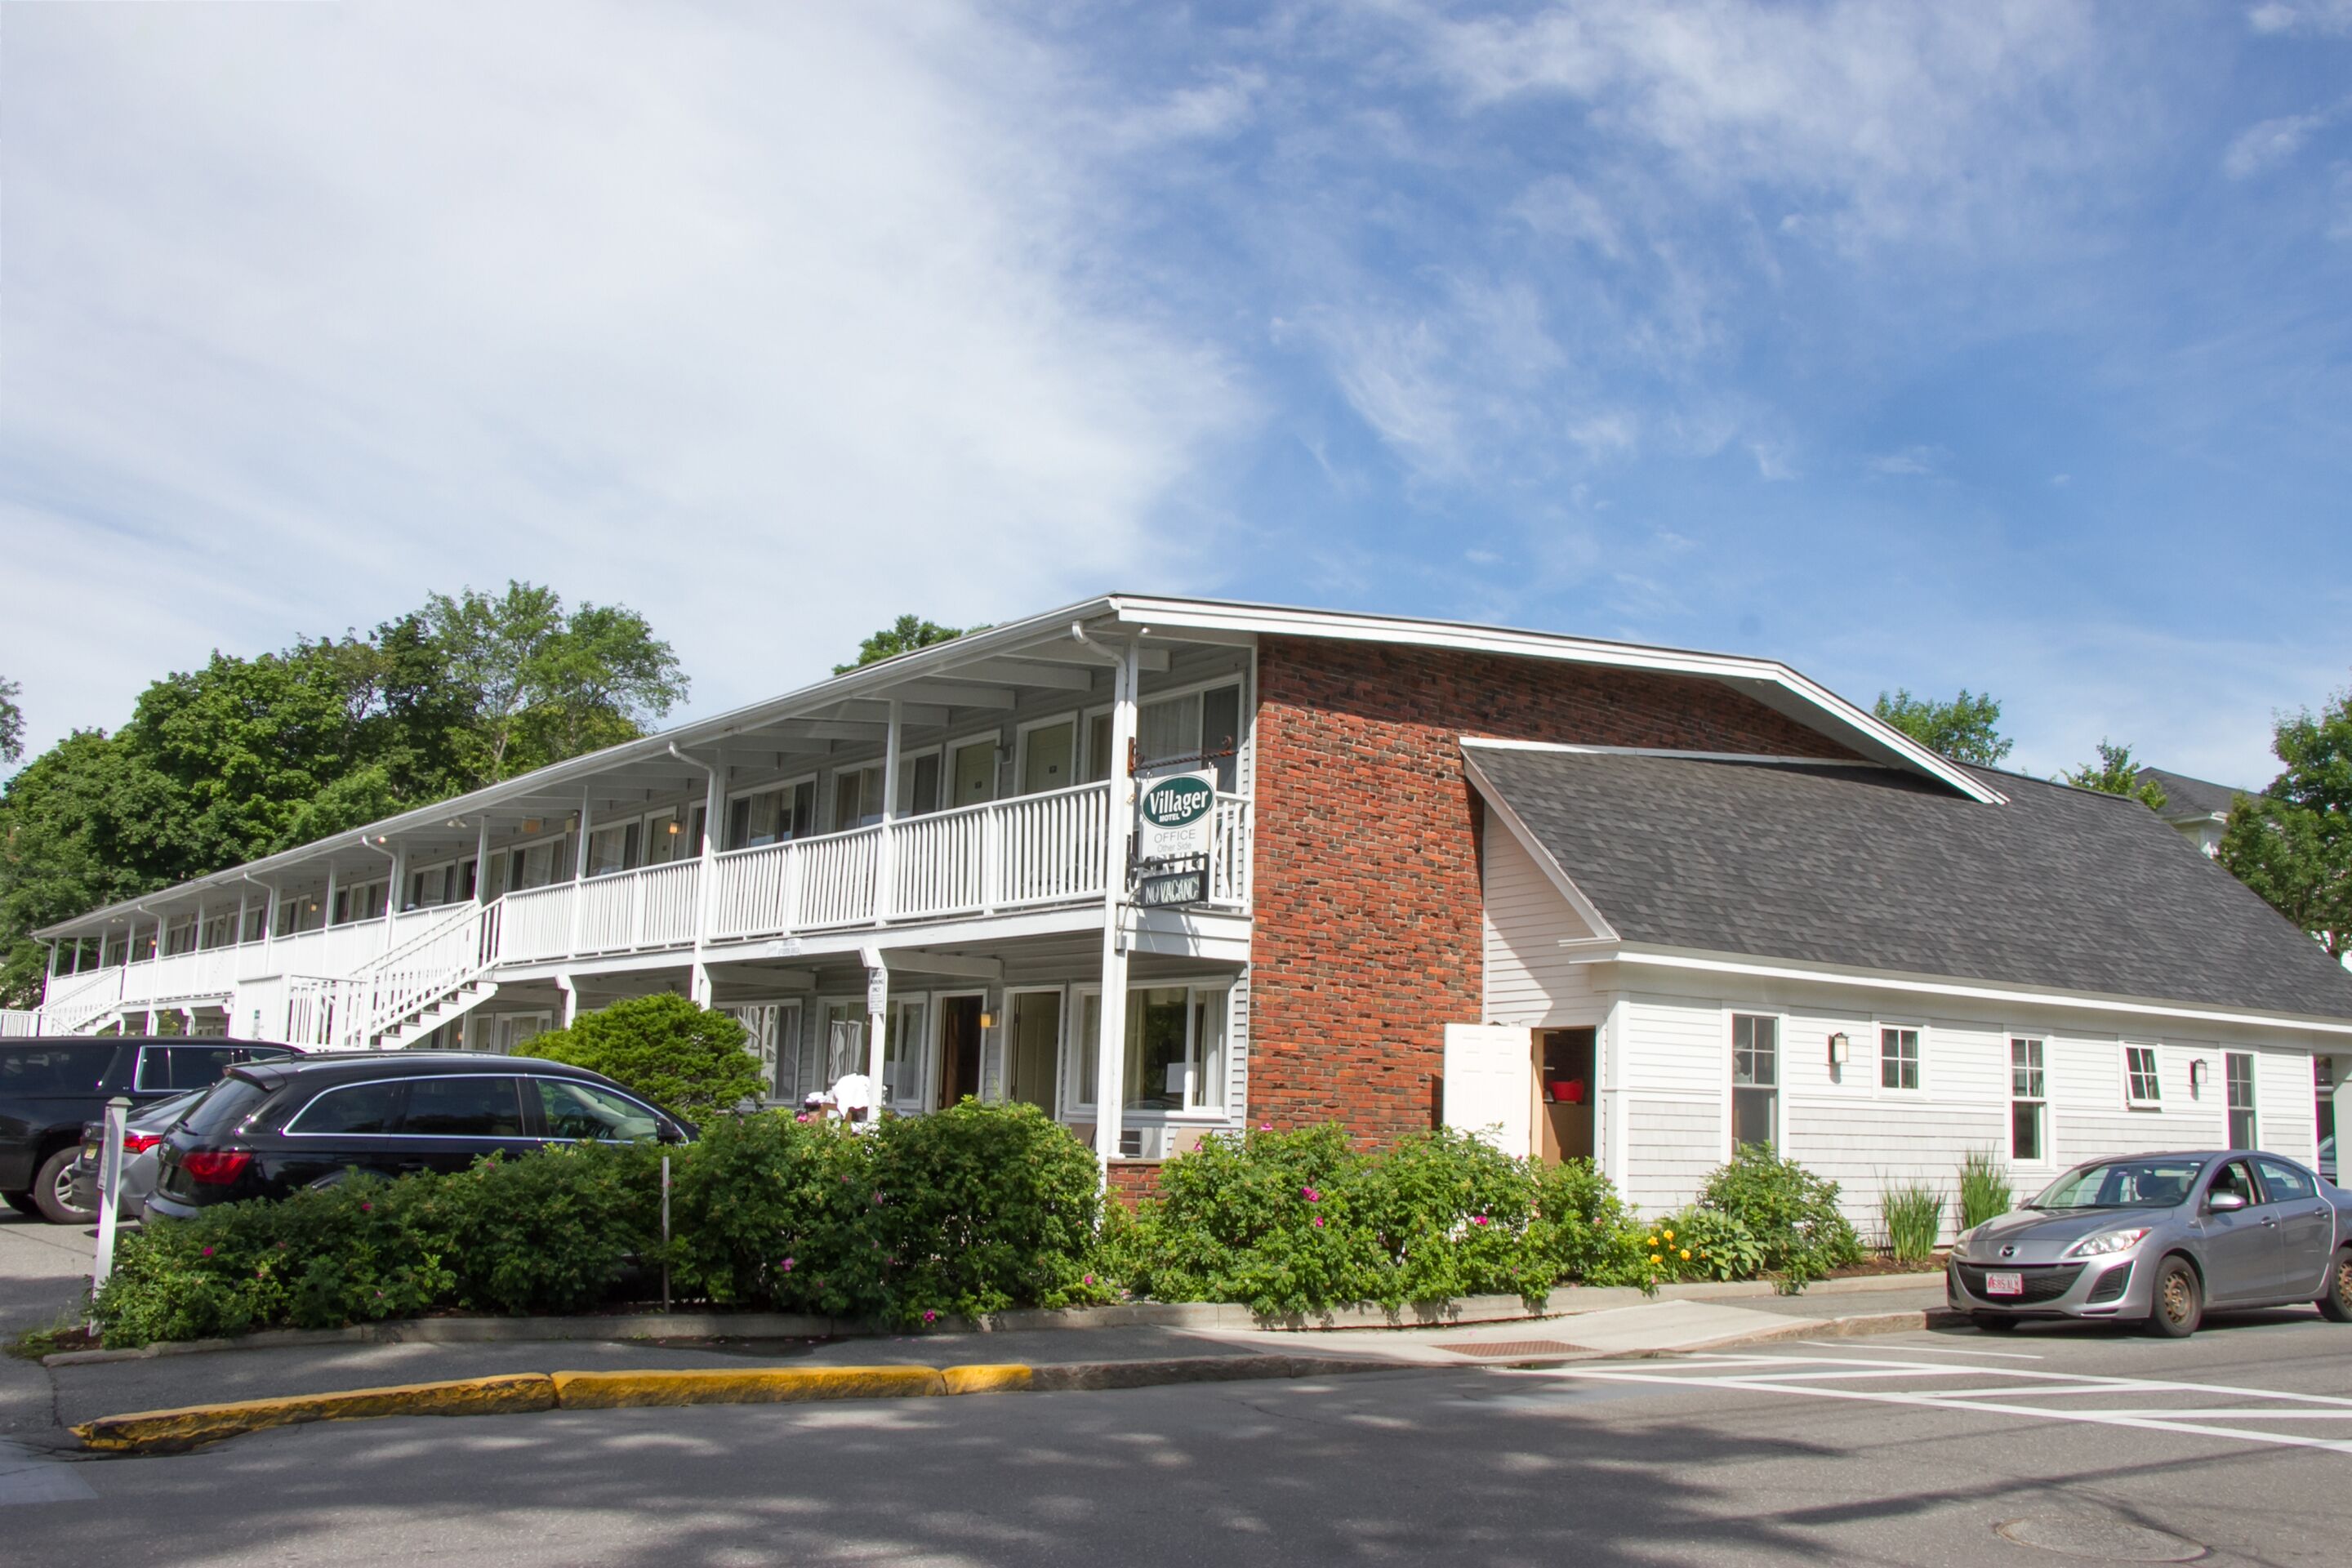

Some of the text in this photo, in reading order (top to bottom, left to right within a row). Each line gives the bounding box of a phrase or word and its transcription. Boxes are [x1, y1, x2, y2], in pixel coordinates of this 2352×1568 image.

[1150, 790, 1209, 817] Villager
[1159, 813, 1181, 823] MOTEL
[1154, 829, 1196, 843] OFFICE
[1157, 842, 1192, 853] Other Side
[1145, 884, 1159, 904] NO
